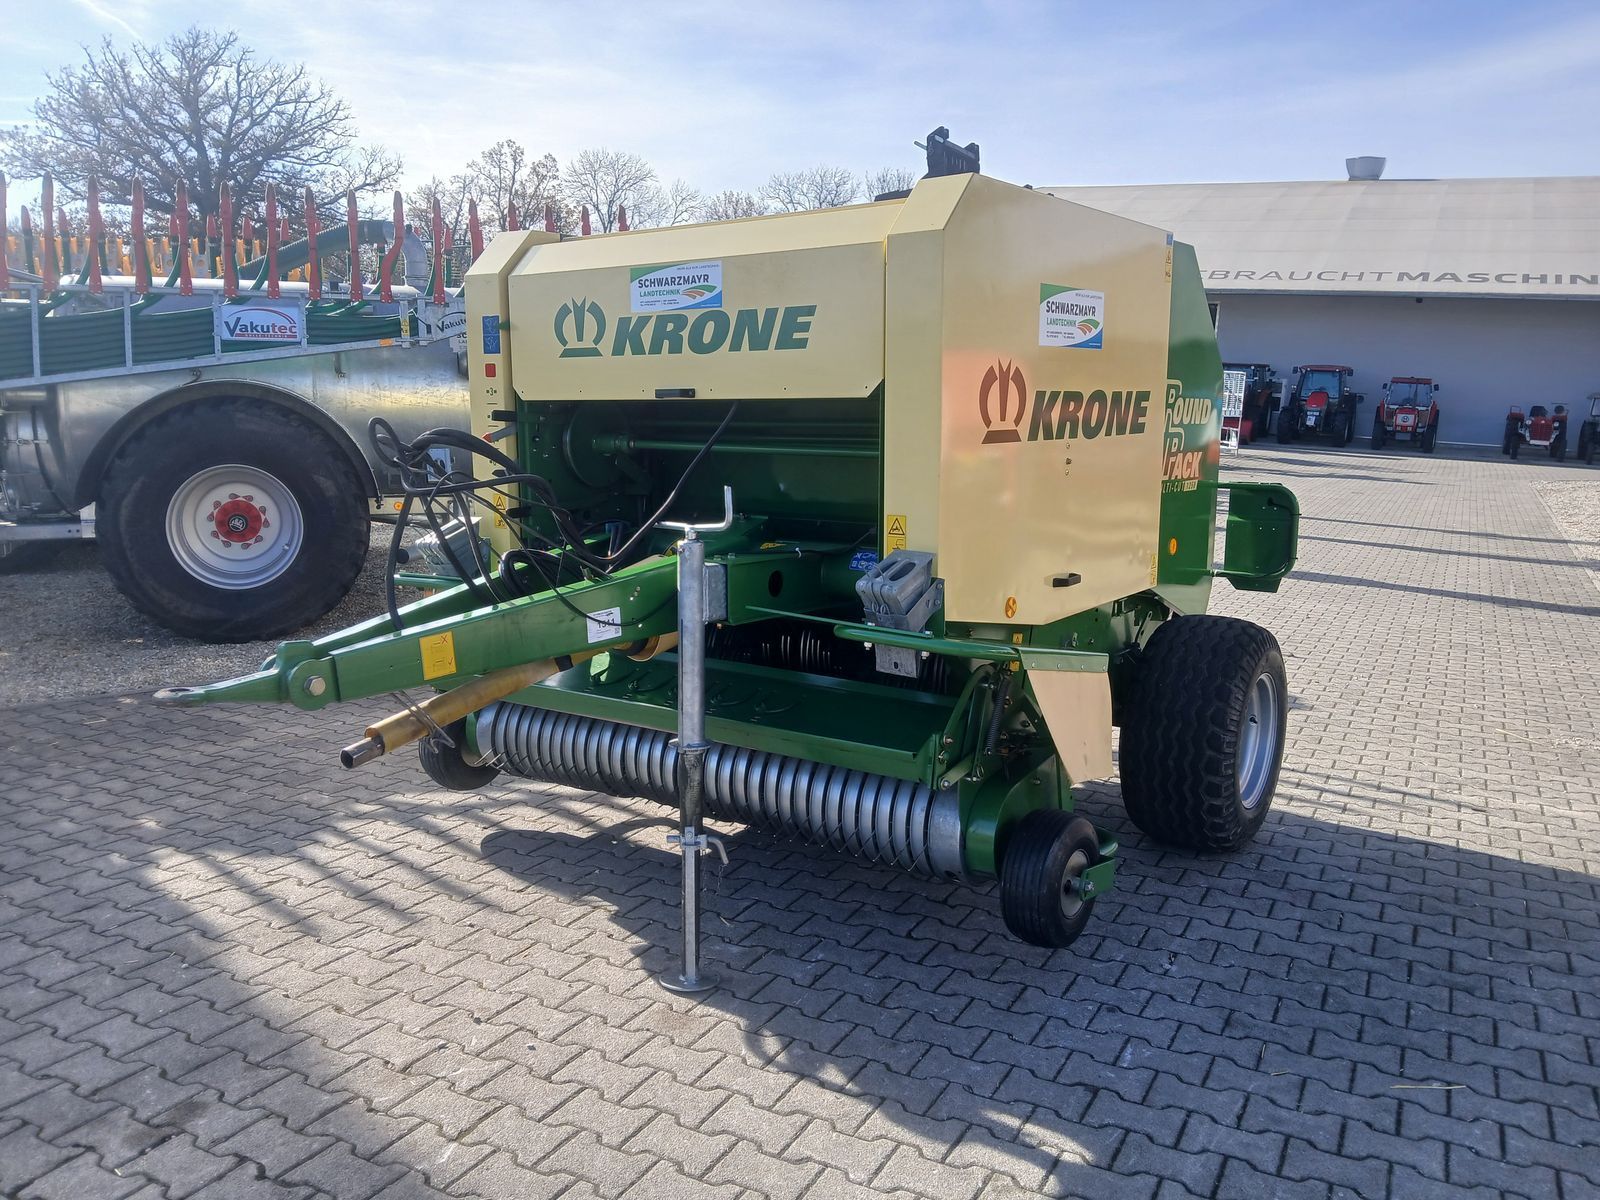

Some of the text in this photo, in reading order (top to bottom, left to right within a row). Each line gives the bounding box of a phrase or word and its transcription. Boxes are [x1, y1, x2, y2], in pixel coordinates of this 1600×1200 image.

[637, 274, 710, 289] SCHWARZMAYR
[639, 289, 681, 298] LANDTECHNIK
[1045, 300, 1097, 317] SCHWARZMAYR
[223, 316, 297, 338] Vakutec
[611, 305, 818, 357] KRONE
[1046, 317, 1077, 328] LANDTECHNIK
[1027, 389, 1152, 442] KRONE
